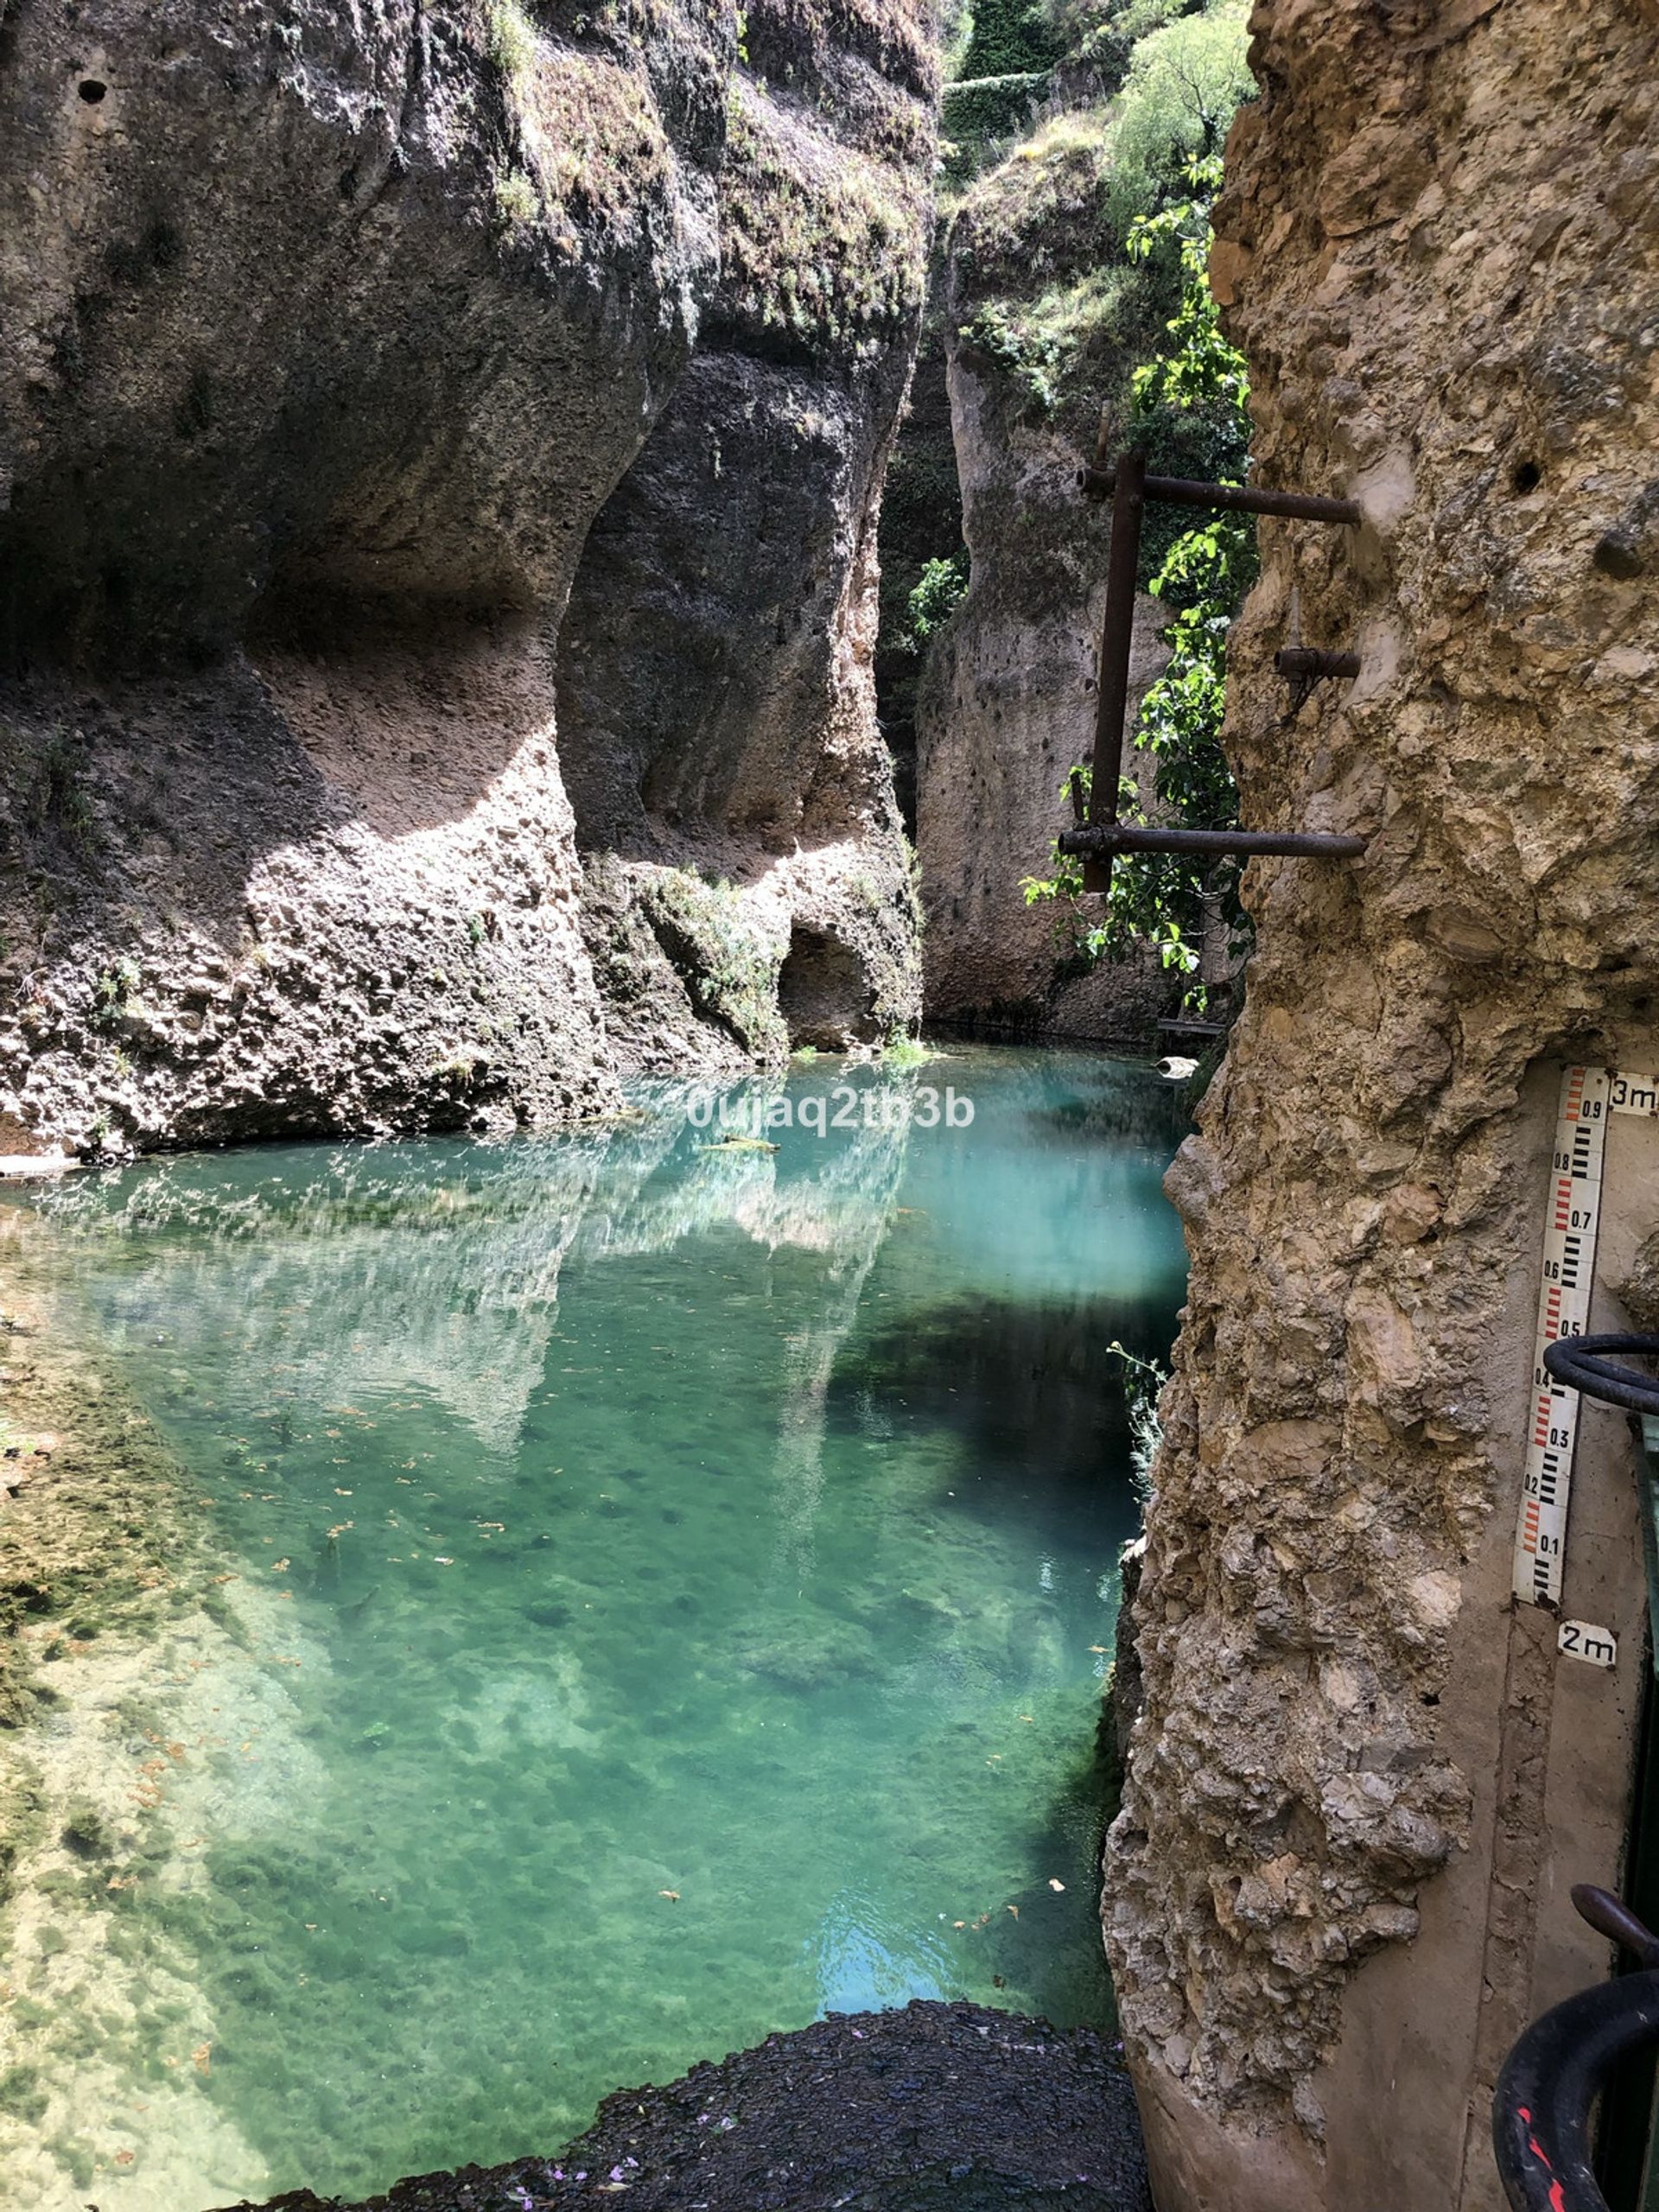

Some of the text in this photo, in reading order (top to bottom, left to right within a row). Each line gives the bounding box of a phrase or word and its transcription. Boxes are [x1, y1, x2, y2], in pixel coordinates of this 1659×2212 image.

[1582, 1101, 1601, 1119] 0.9
[1554, 1153, 1569, 1171] 0.8
[1572, 1210, 1592, 1230] 0.7
[1544, 1260, 1559, 1280] 0.6
[1560, 1320, 1580, 1338] 0.5
[1535, 1367, 1549, 1389] 0.4
[1549, 1427, 1568, 1448] 0.3
[1524, 1474, 1537, 1494] 0.2
[1540, 1535, 1559, 1555] 0.1
